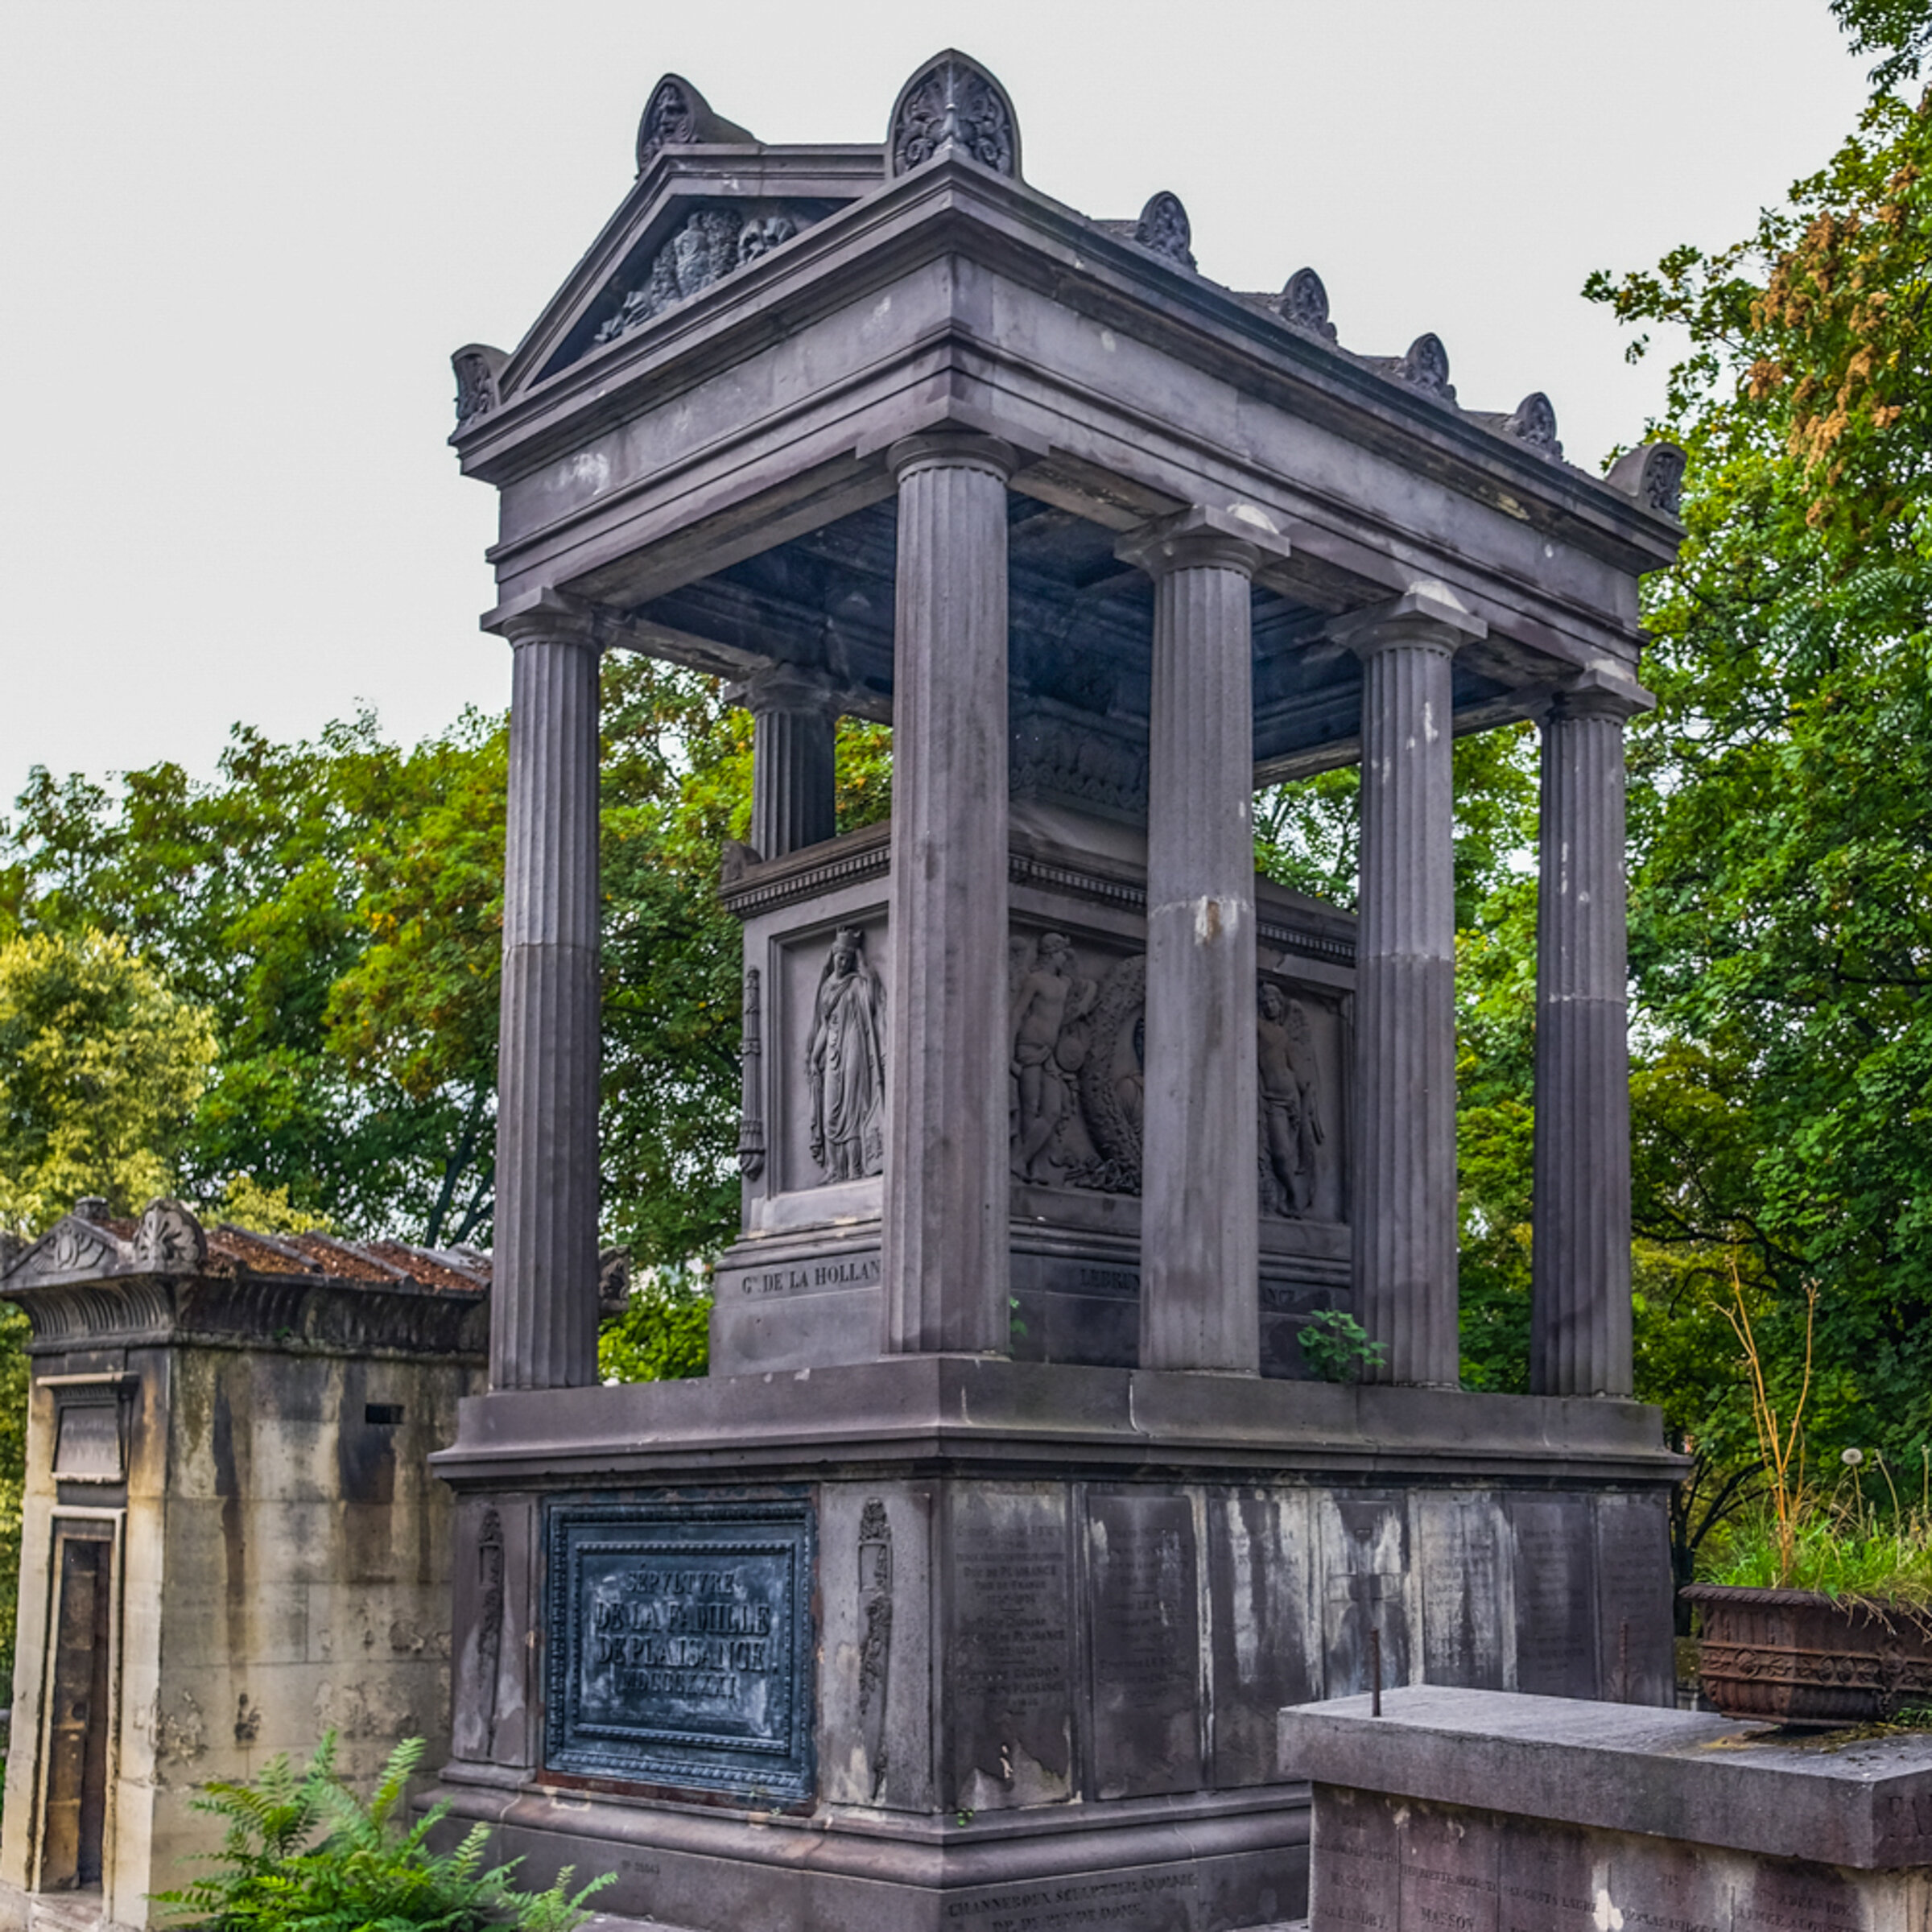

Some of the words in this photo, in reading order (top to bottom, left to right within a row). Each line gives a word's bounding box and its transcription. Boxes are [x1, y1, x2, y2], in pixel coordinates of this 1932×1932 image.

[763, 1273, 783, 1293] DE
[790, 1269, 809, 1290] LA
[597, 1601, 624, 1631] DE
[630, 1601, 661, 1632] LA
[668, 1601, 770, 1634] FAMILLE
[598, 1633, 626, 1664] DE
